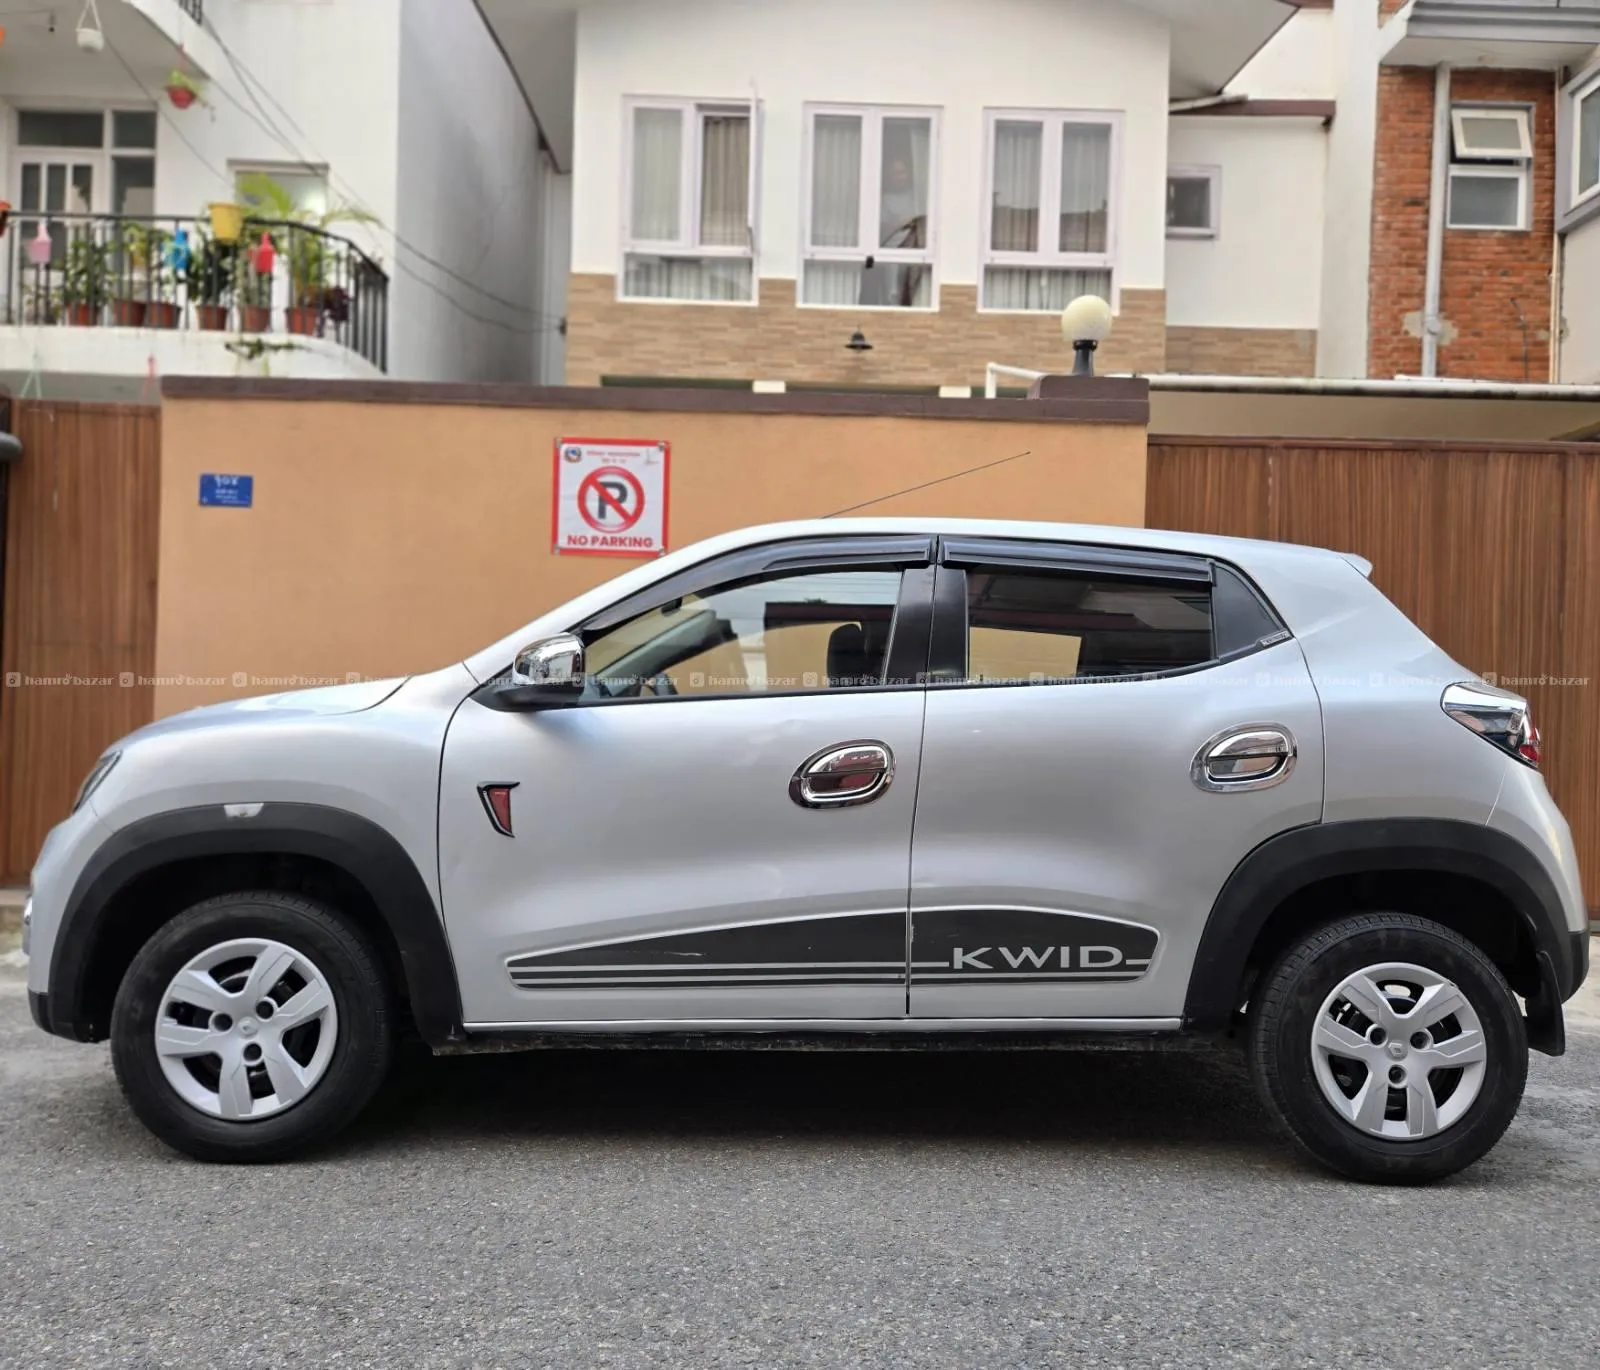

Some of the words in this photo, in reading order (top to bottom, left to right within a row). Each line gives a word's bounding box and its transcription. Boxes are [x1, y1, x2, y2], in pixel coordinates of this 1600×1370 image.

[567, 535, 588, 547] NO
[590, 535, 654, 548] PARKING
[953, 946, 1123, 969] KWID
